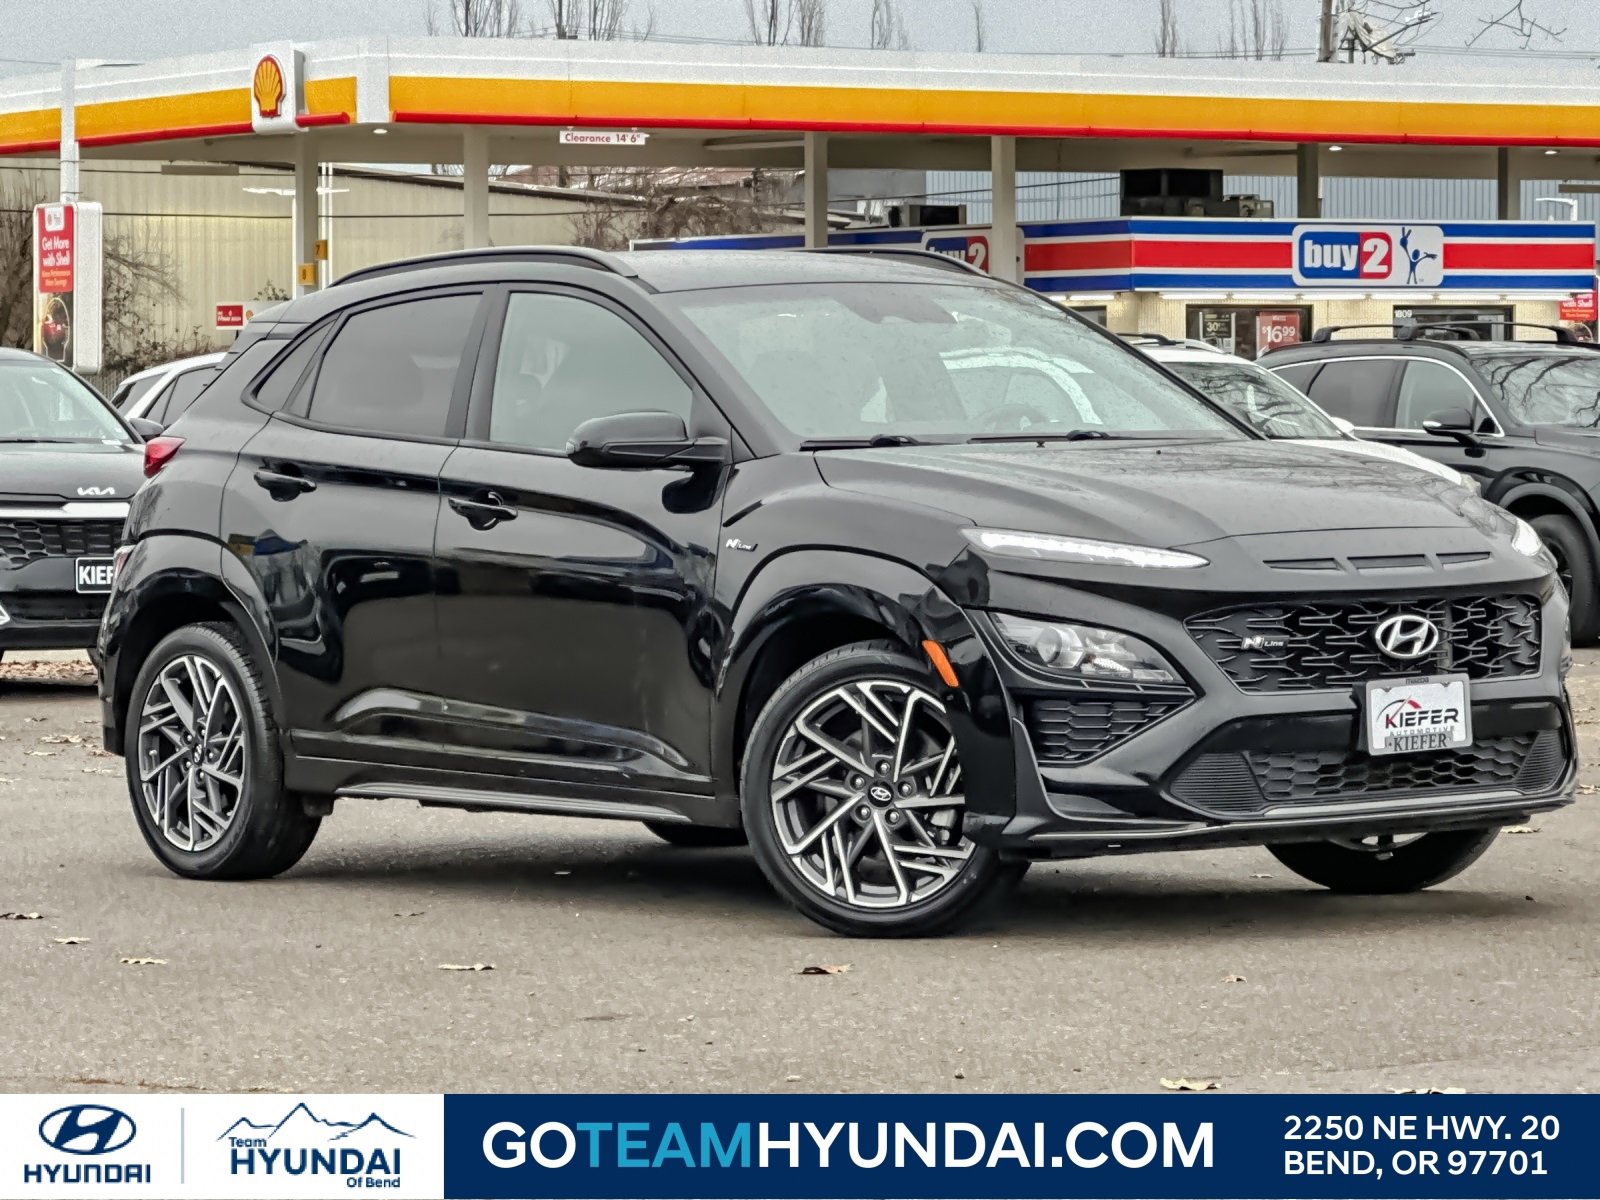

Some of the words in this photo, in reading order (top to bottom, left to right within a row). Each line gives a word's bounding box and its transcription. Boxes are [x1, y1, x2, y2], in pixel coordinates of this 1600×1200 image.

[565, 133, 611, 143] Clearance
[616, 133, 628, 143] 14'
[630, 134, 641, 143] 6"
[41, 236, 53, 251] Get
[53, 235, 70, 250] More
[43, 252, 56, 267] with
[56, 250, 70, 267] Shell
[315, 244, 321, 258] 7
[1303, 238, 1390, 273] buy2
[1577, 299, 1593, 308] Shell
[1394, 309, 1413, 318] 1809
[1386, 707, 1460, 729] KIEFER
[1390, 725, 1454, 737] AUTOMOTIVE
[1393, 733, 1448, 752] KIEFER
